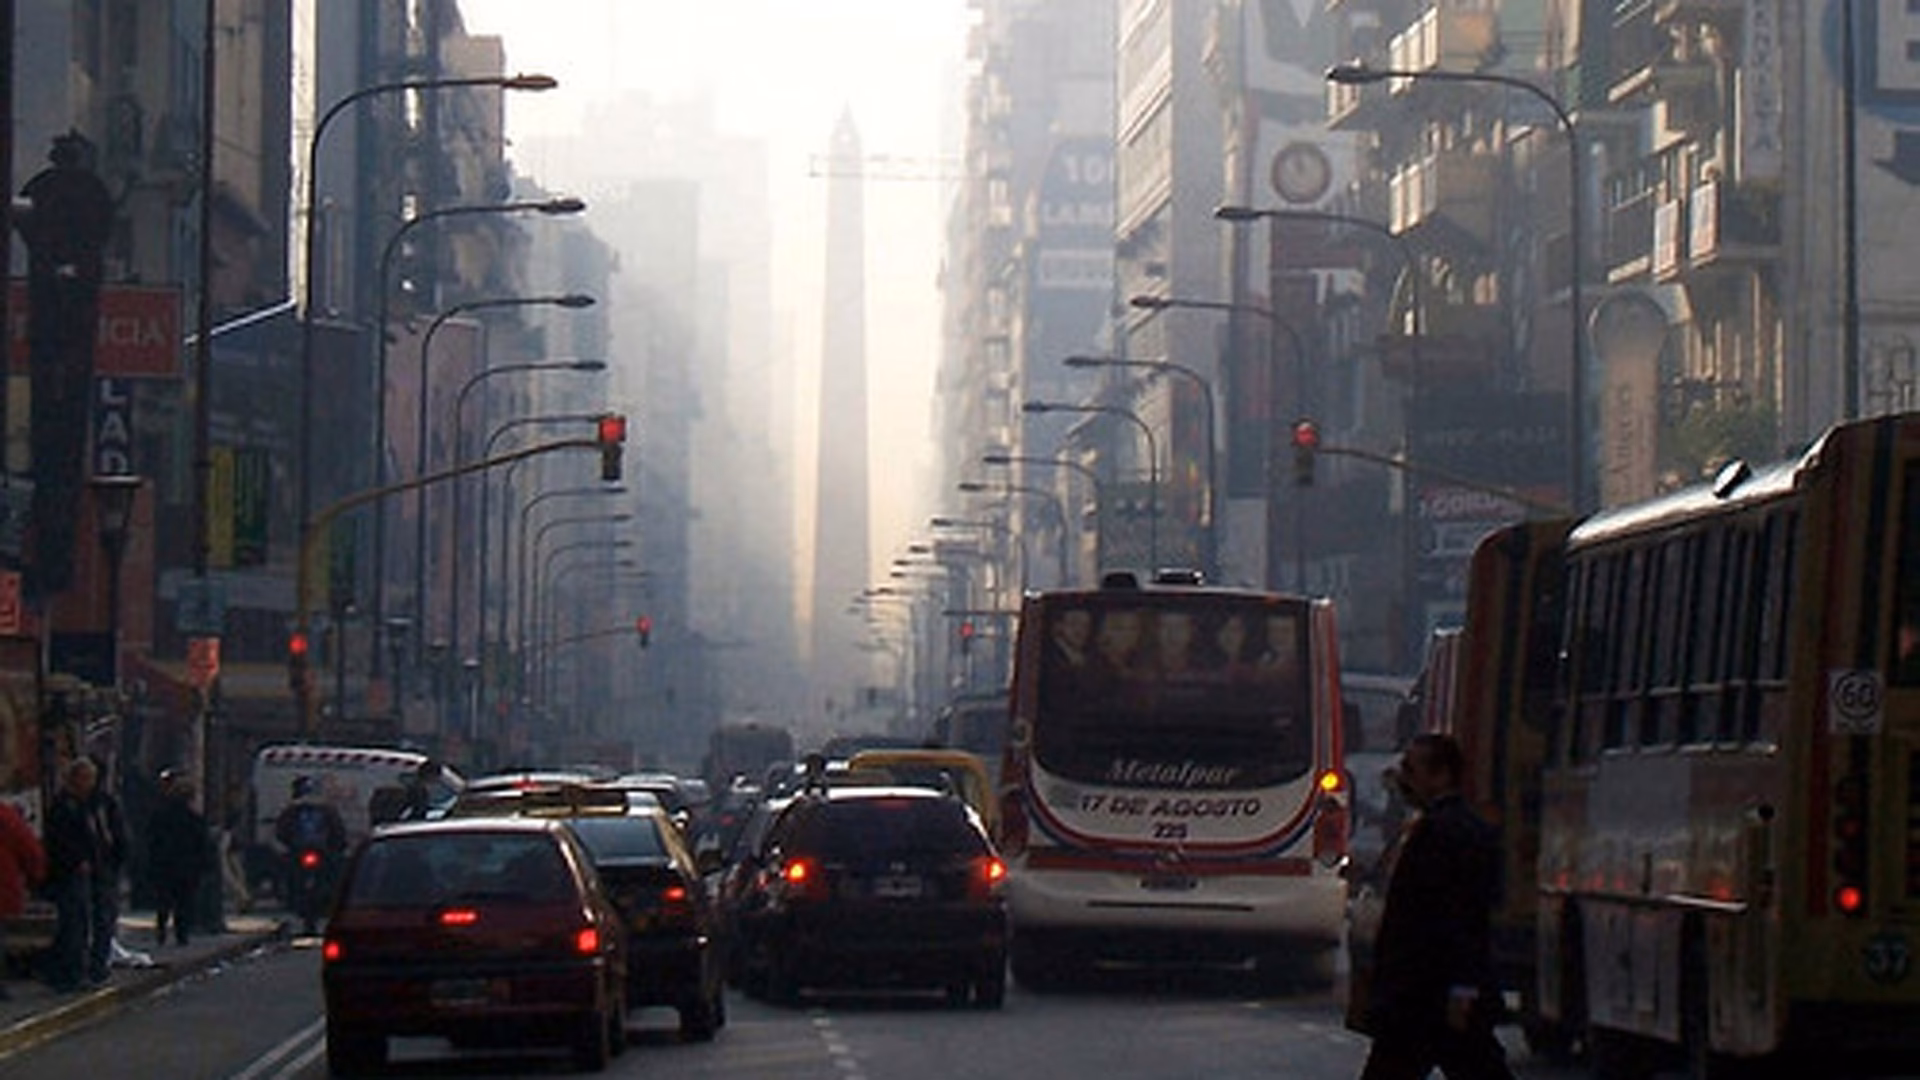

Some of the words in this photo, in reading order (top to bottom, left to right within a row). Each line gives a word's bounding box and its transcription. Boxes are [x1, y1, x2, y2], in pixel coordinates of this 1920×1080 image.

[1841, 681, 1875, 708] 60
[1106, 758, 1239, 788] Metalpar
[1081, 794, 1107, 813] 17
[1109, 796, 1147, 815] DE
[1150, 797, 1262, 817] AGOSTO
